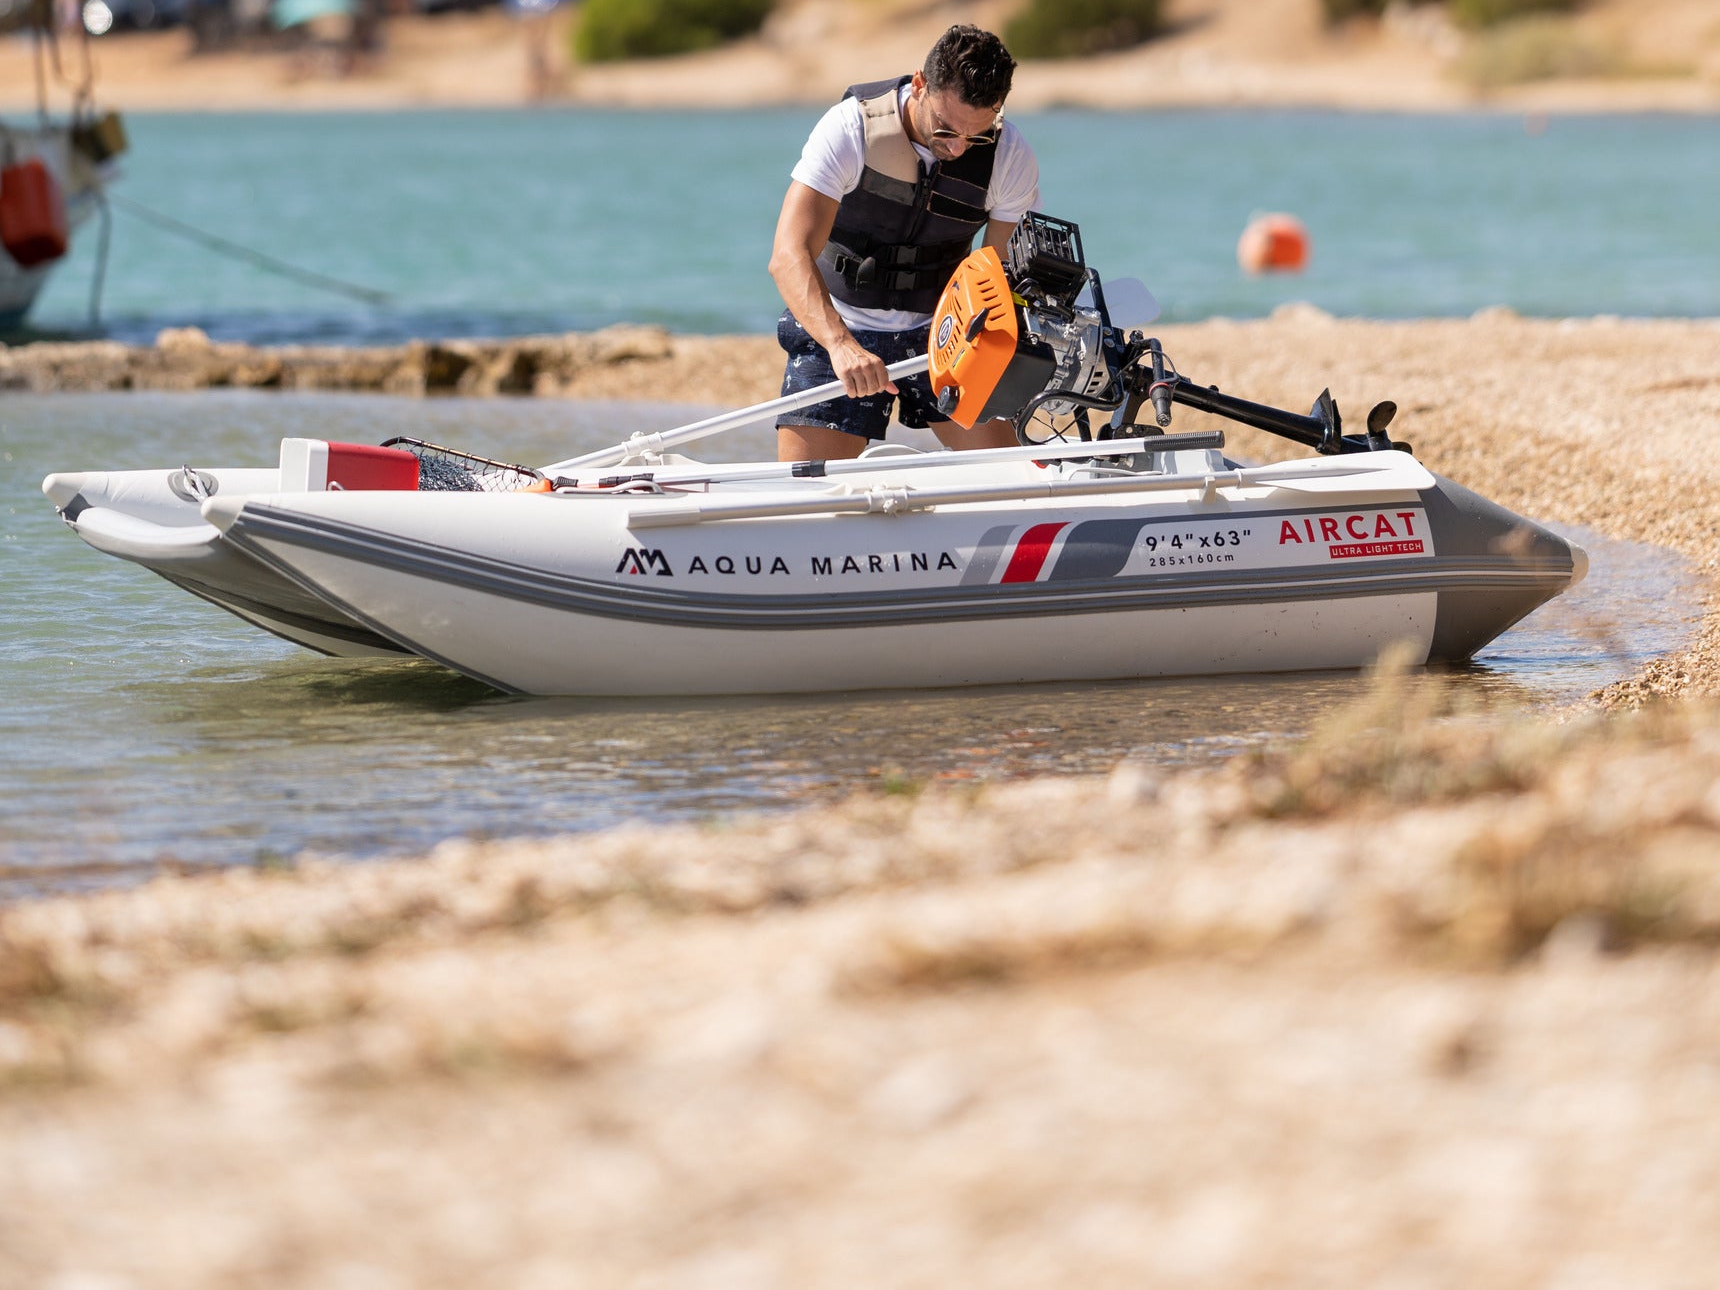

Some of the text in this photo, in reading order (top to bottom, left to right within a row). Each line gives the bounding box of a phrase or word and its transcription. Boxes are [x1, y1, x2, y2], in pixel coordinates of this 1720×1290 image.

[1279, 512, 1415, 544] AIRCAT
[1331, 542, 1422, 556] ULTRA LIGHT TECH
[688, 555, 790, 575] AQUA
[811, 551, 957, 576] MARINA
[1149, 553, 1234, 567] 285x160cm
